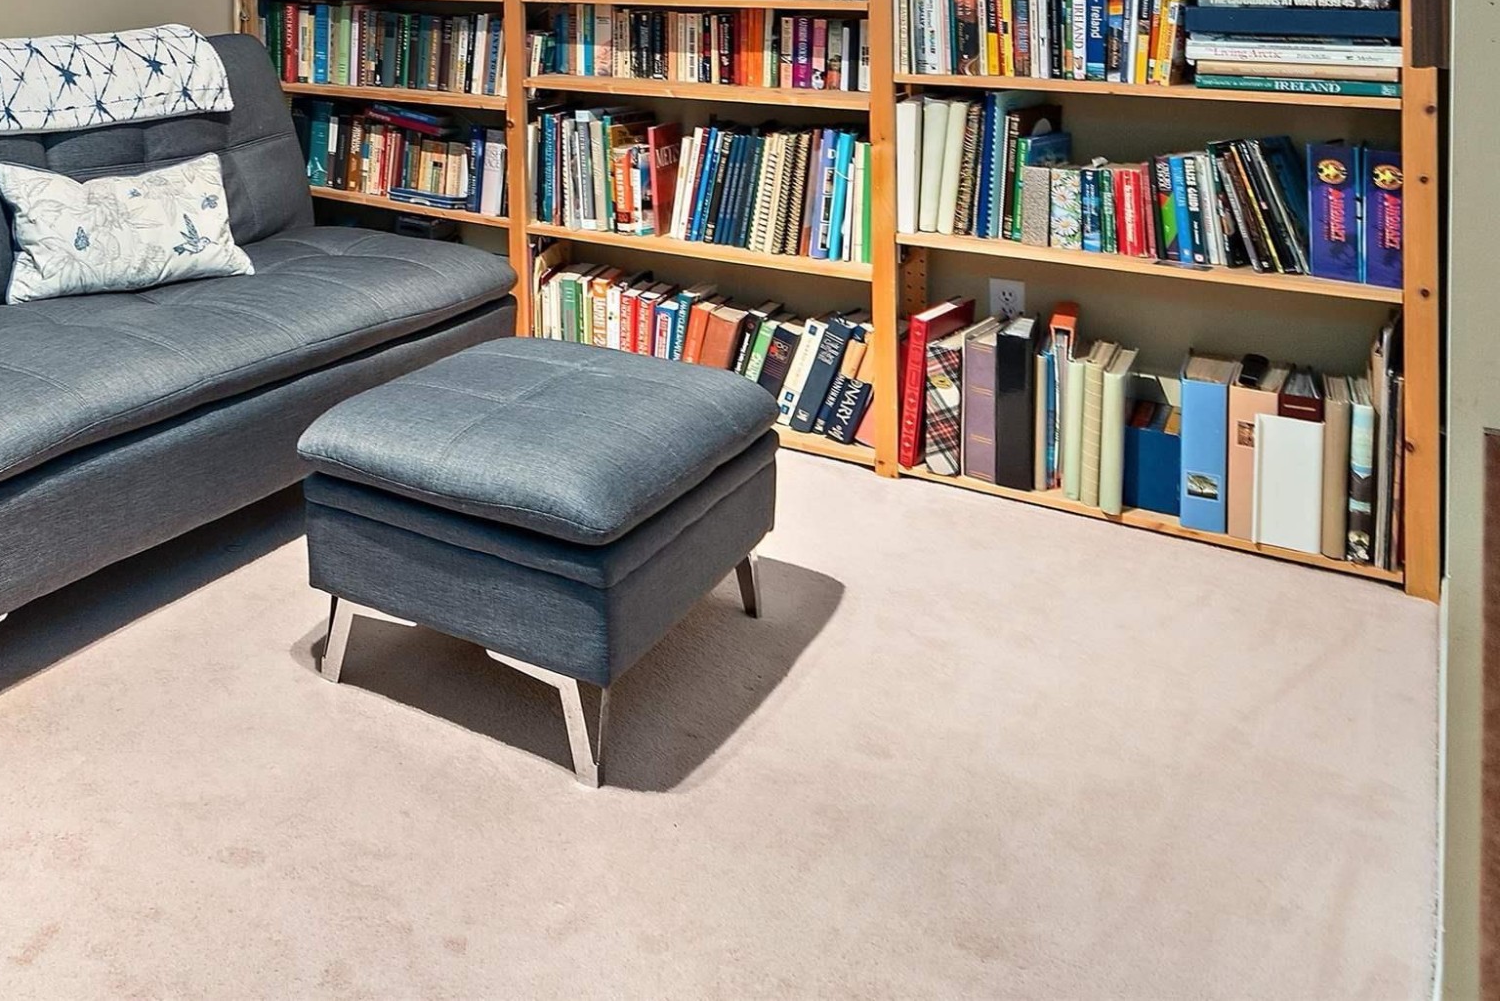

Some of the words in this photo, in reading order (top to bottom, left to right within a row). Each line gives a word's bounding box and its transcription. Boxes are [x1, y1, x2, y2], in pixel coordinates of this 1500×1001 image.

[285, 6, 294, 49] PSYCHOLOGY
[900, 4, 908, 26] BANKS
[1074, 3, 1084, 50] IRELAND
[1090, 5, 1102, 39] Ireland
[1274, 80, 1341, 94] IRELAND
[1184, 158, 1198, 186] BELIZE
[1187, 187, 1199, 212] GUIDE
[1328, 188, 1346, 242] AIRCRAFT
[1384, 193, 1401, 250] AIRCRAFT
